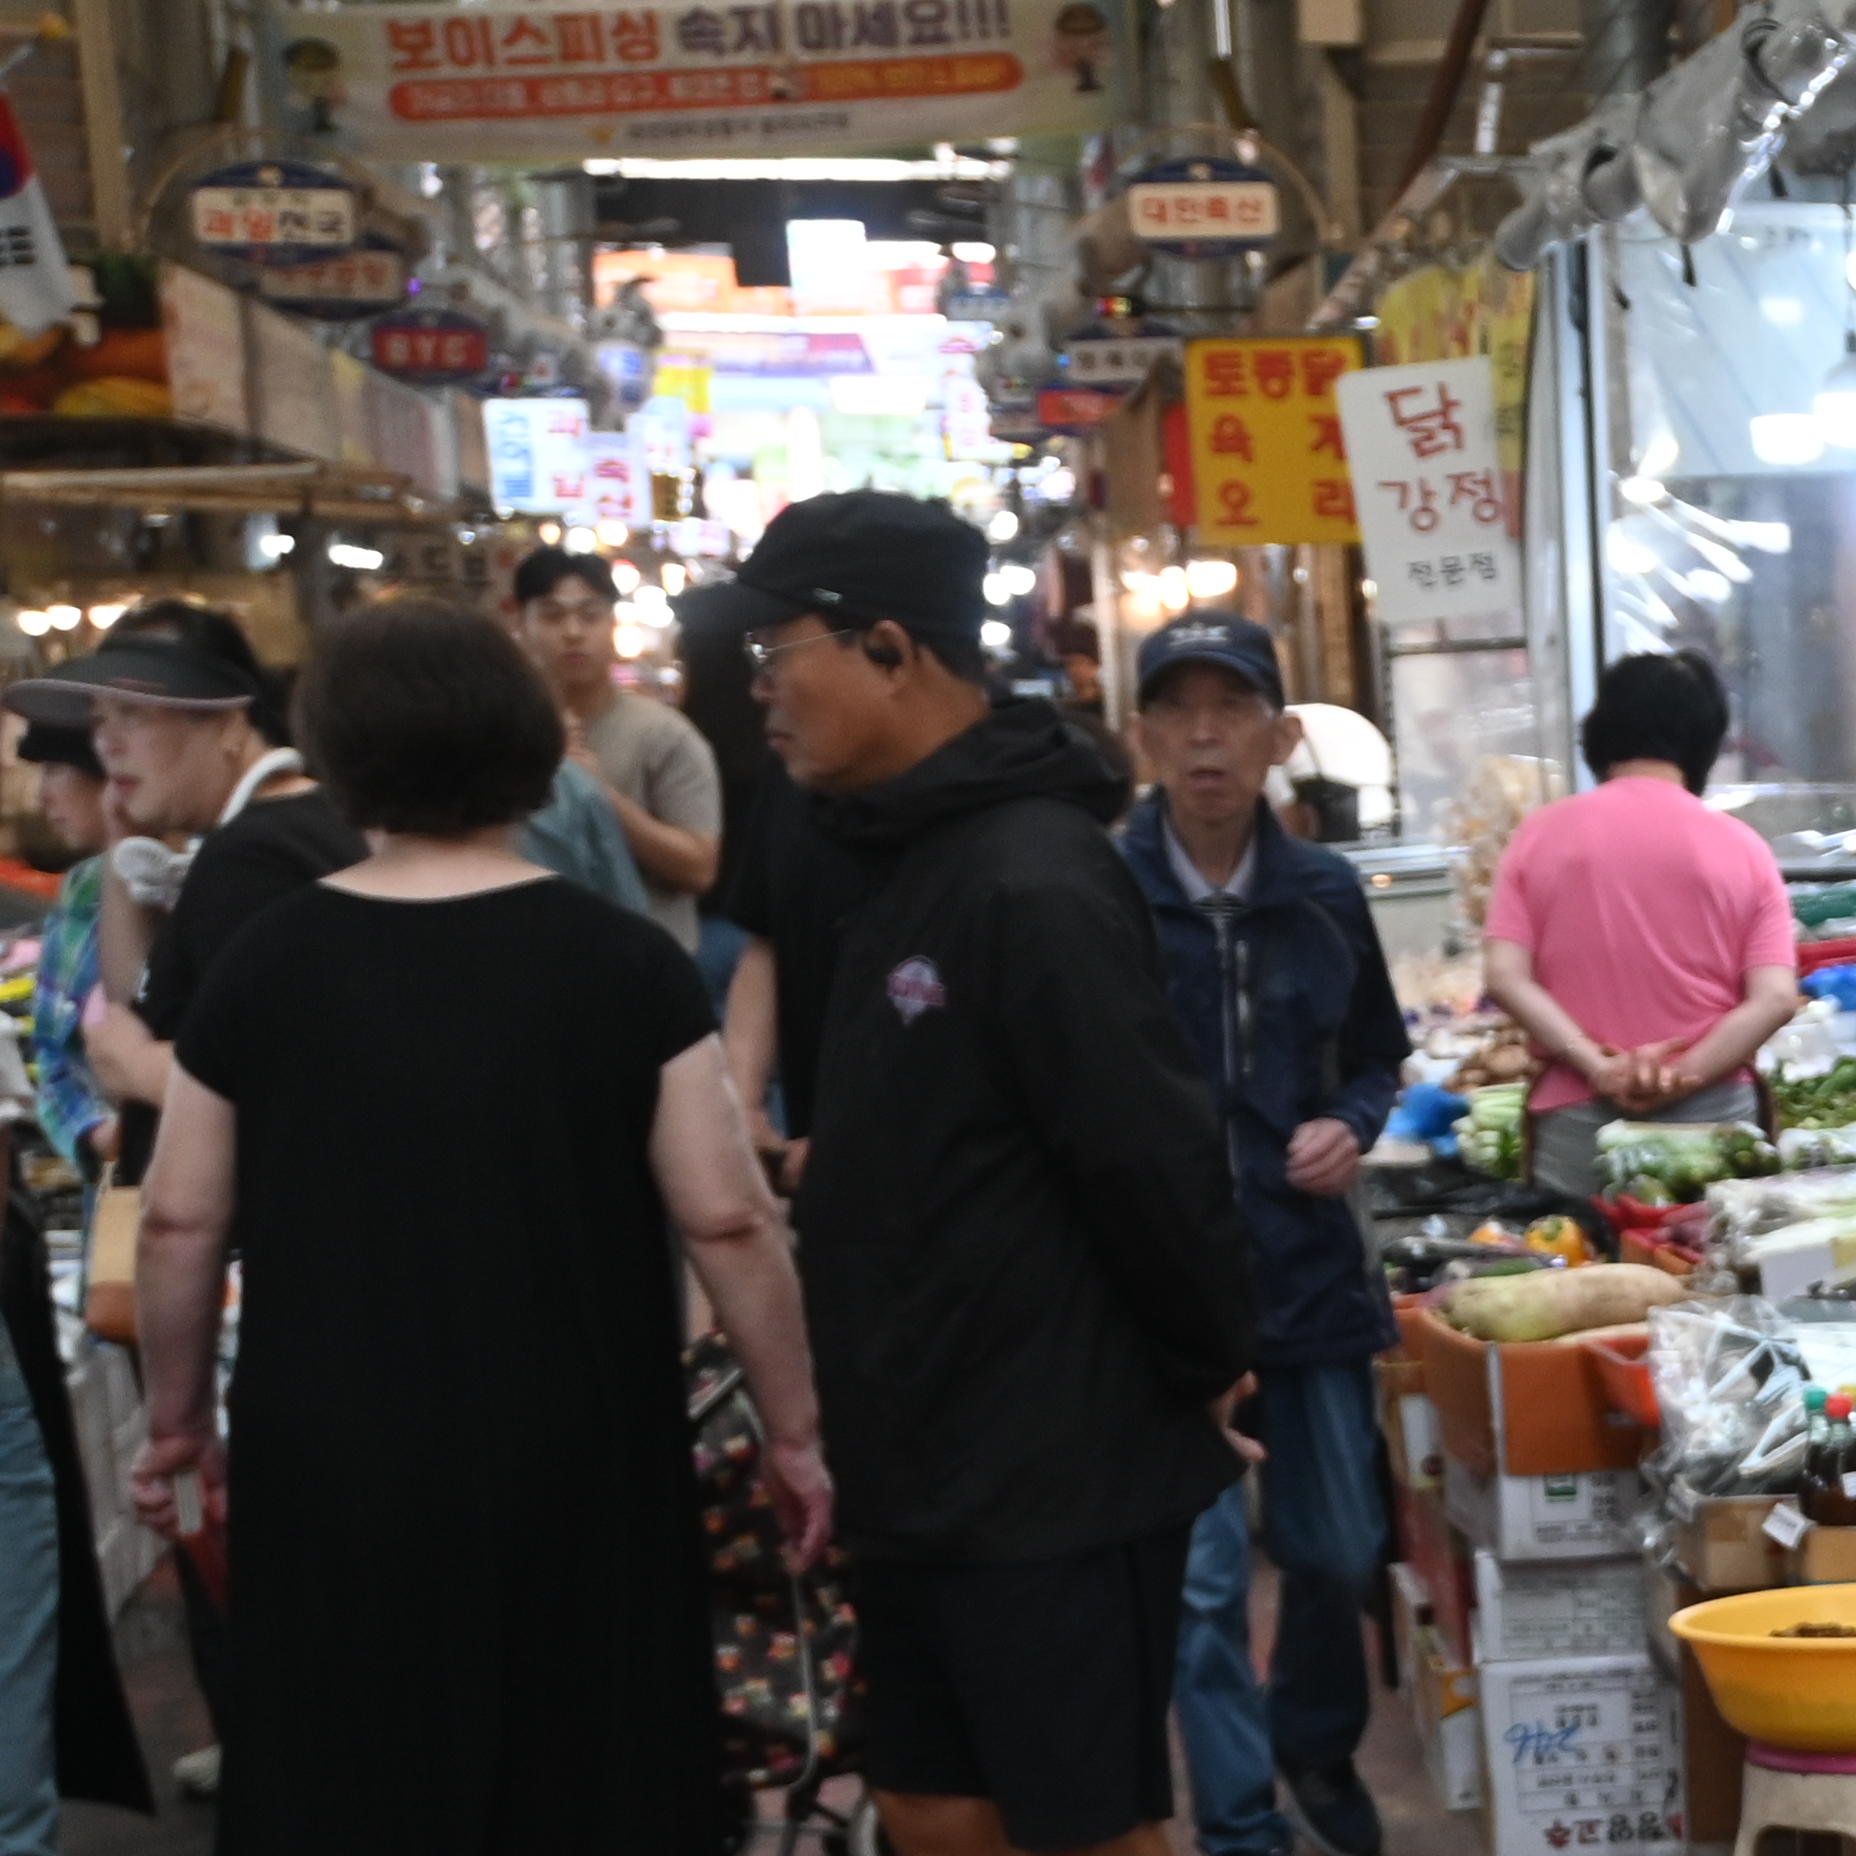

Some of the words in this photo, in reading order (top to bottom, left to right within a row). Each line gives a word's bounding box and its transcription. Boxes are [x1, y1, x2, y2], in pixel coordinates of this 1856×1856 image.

[386, 10, 661, 70] 보이스피싱
[676, 5, 785, 56] 속지
[1384, 380, 1463, 458] 닭
[1377, 467, 1500, 531] 강정
